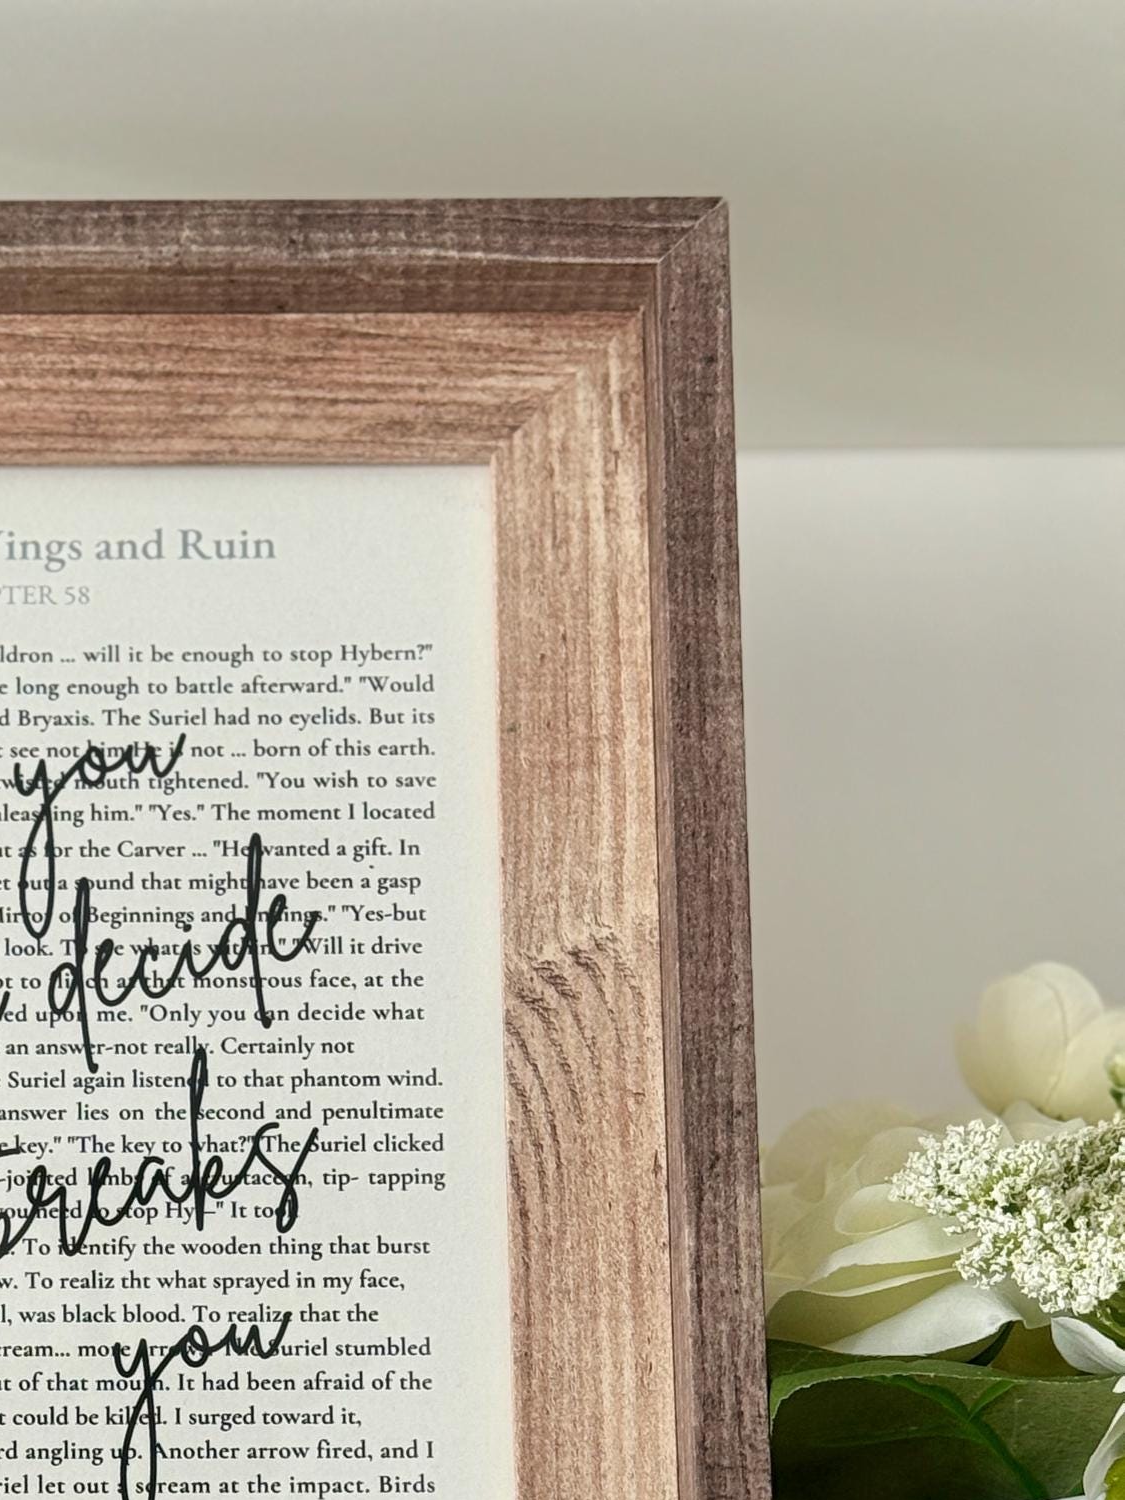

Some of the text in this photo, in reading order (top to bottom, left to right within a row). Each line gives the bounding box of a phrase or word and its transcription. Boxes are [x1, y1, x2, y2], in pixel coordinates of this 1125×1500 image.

[95, 527, 166, 561] and
[178, 528, 276, 561] Ruin
[64, 585, 91, 606] 58
[82, 644, 120, 663] will
[128, 646, 143, 663] it
[150, 644, 174, 663] be
[181, 643, 254, 669] enough
[262, 650, 283, 662] to
[290, 649, 333, 668] stop
[340, 642, 433, 668] Hybern?"
[15, 676, 60, 702] long
[66, 675, 140, 701] enough
[147, 682, 168, 695] to
[175, 675, 234, 695] battle
[240, 674, 352, 694] afterward."
[358, 673, 435, 693] "Would
[14, 732, 186, 938] you
[48, 833, 319, 1074] decide
[7, 1068, 66, 1089] Suriel
[72, 1070, 126, 1095] again
[216, 1074, 238, 1088] to
[242, 1067, 285, 1088] that
[290, 1067, 382, 1094] phantom
[386, 1066, 444, 1087] wind.
[75, 1101, 110, 1121] lies
[118, 1108, 145, 1121] on
[154, 1101, 187, 1121] the
[196, 1100, 266, 1122] second
[275, 1100, 312, 1121] and
[321, 1100, 444, 1127] penultimate
[18, 1370, 44, 1392] of
[45, 1370, 89, 1392] that
[177, 1372, 196, 1392] It
[201, 1370, 240, 1392] had
[246, 1370, 296, 1392] been
[302, 1369, 365, 1391] afraid
[371, 1369, 396, 1391] of
[399, 1370, 433, 1391] the
